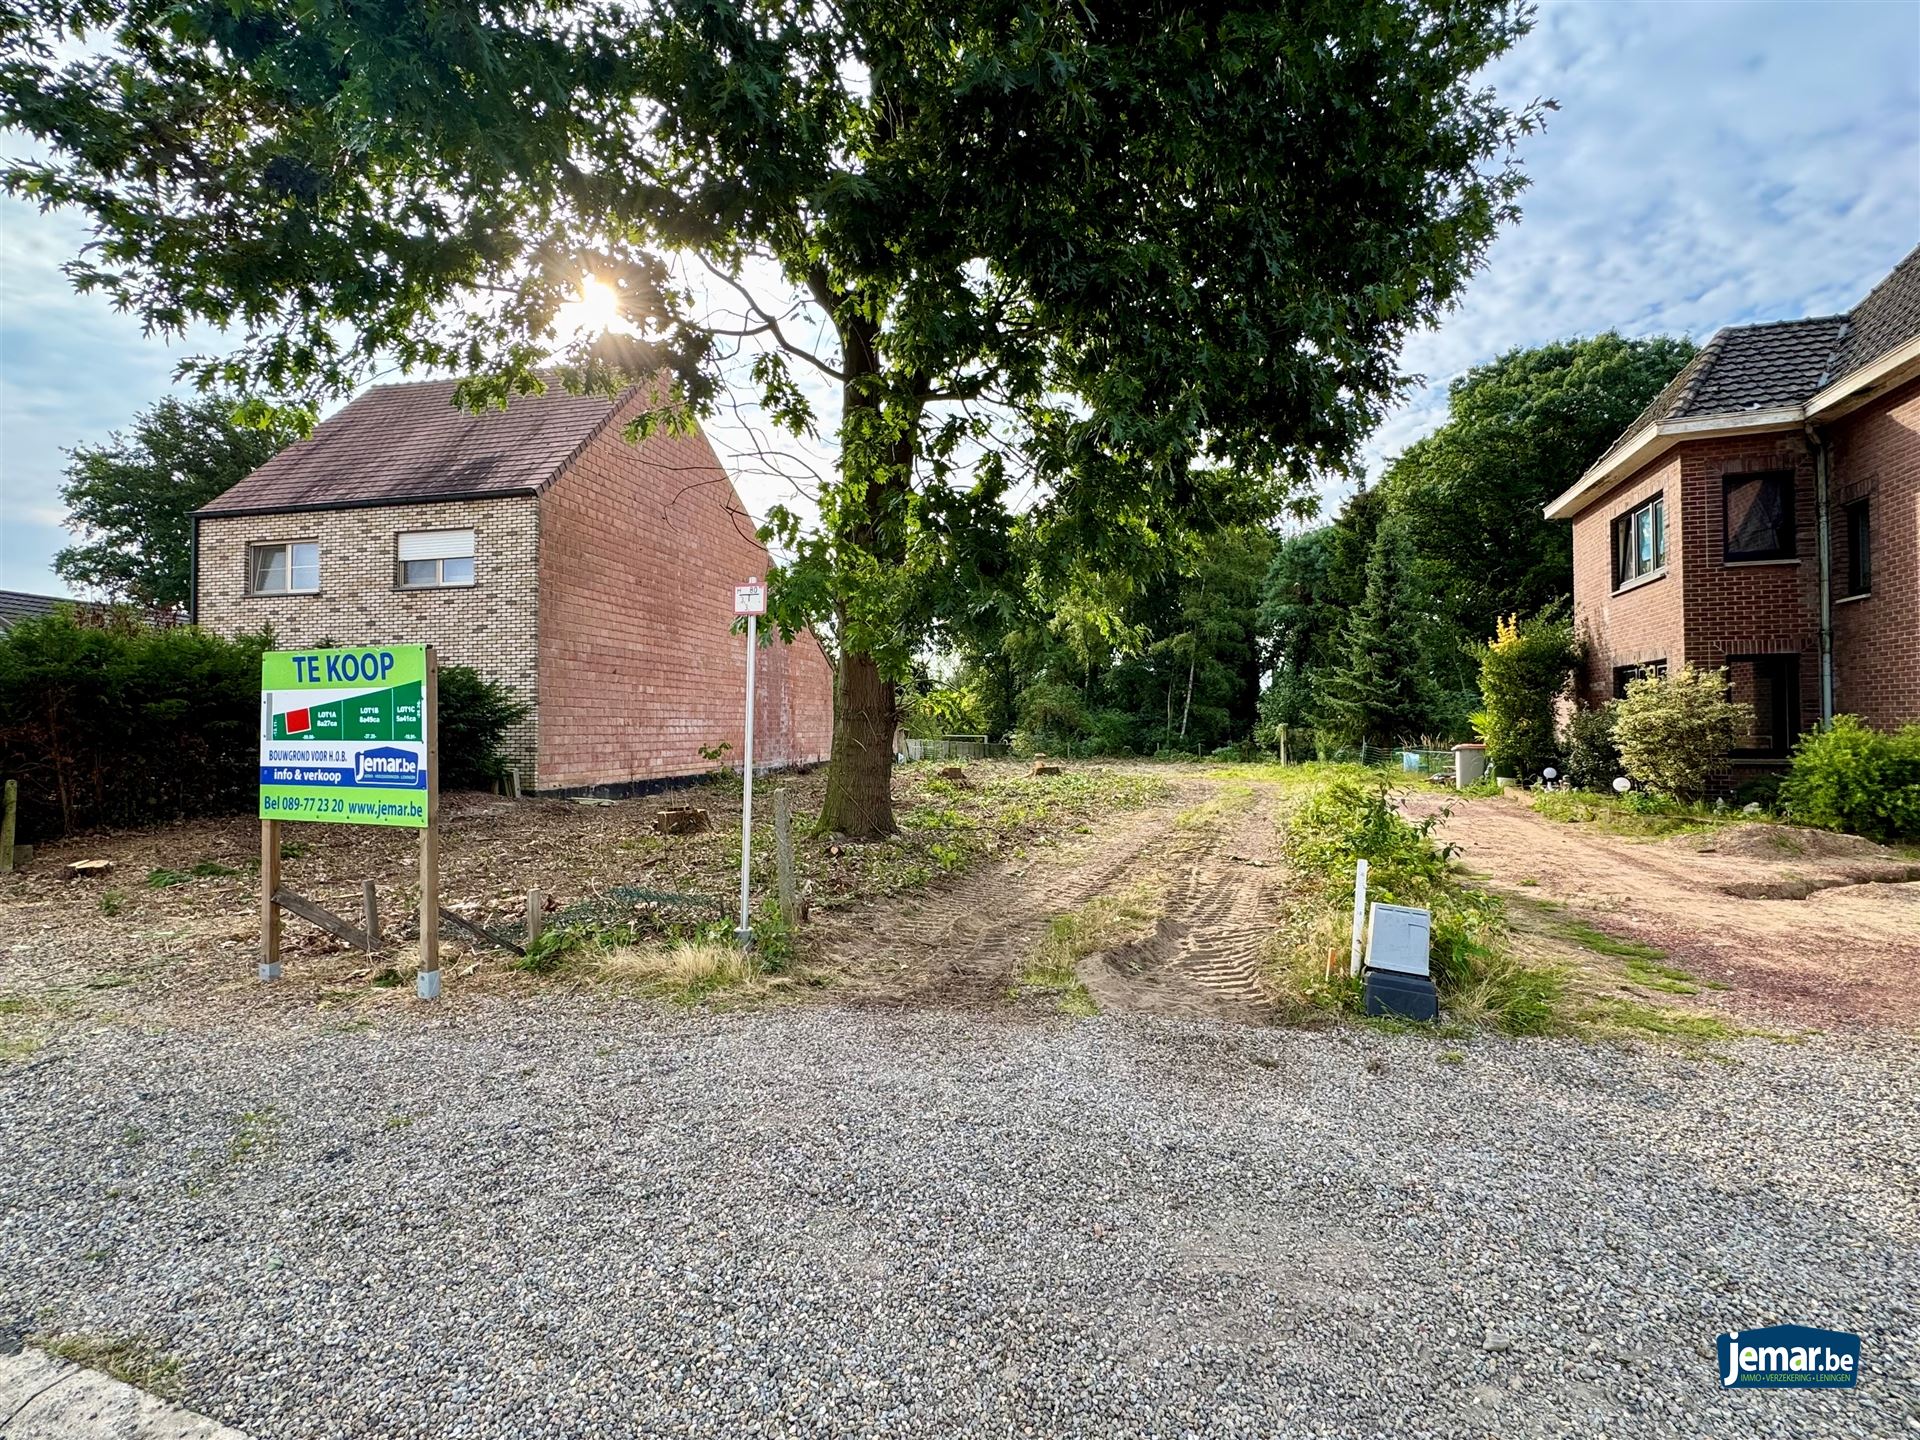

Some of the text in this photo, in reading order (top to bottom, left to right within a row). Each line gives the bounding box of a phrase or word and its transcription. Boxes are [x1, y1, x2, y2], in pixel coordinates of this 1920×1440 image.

[292, 652, 394, 683] TE KOOP
[268, 750, 348, 762] BOUWGROND VOOR H.O.B.
[356, 752, 416, 781] jemar.be
[274, 768, 342, 784] info & verkoop
[264, 796, 423, 818] Bel 089-77 23 20 www.jemar.be
